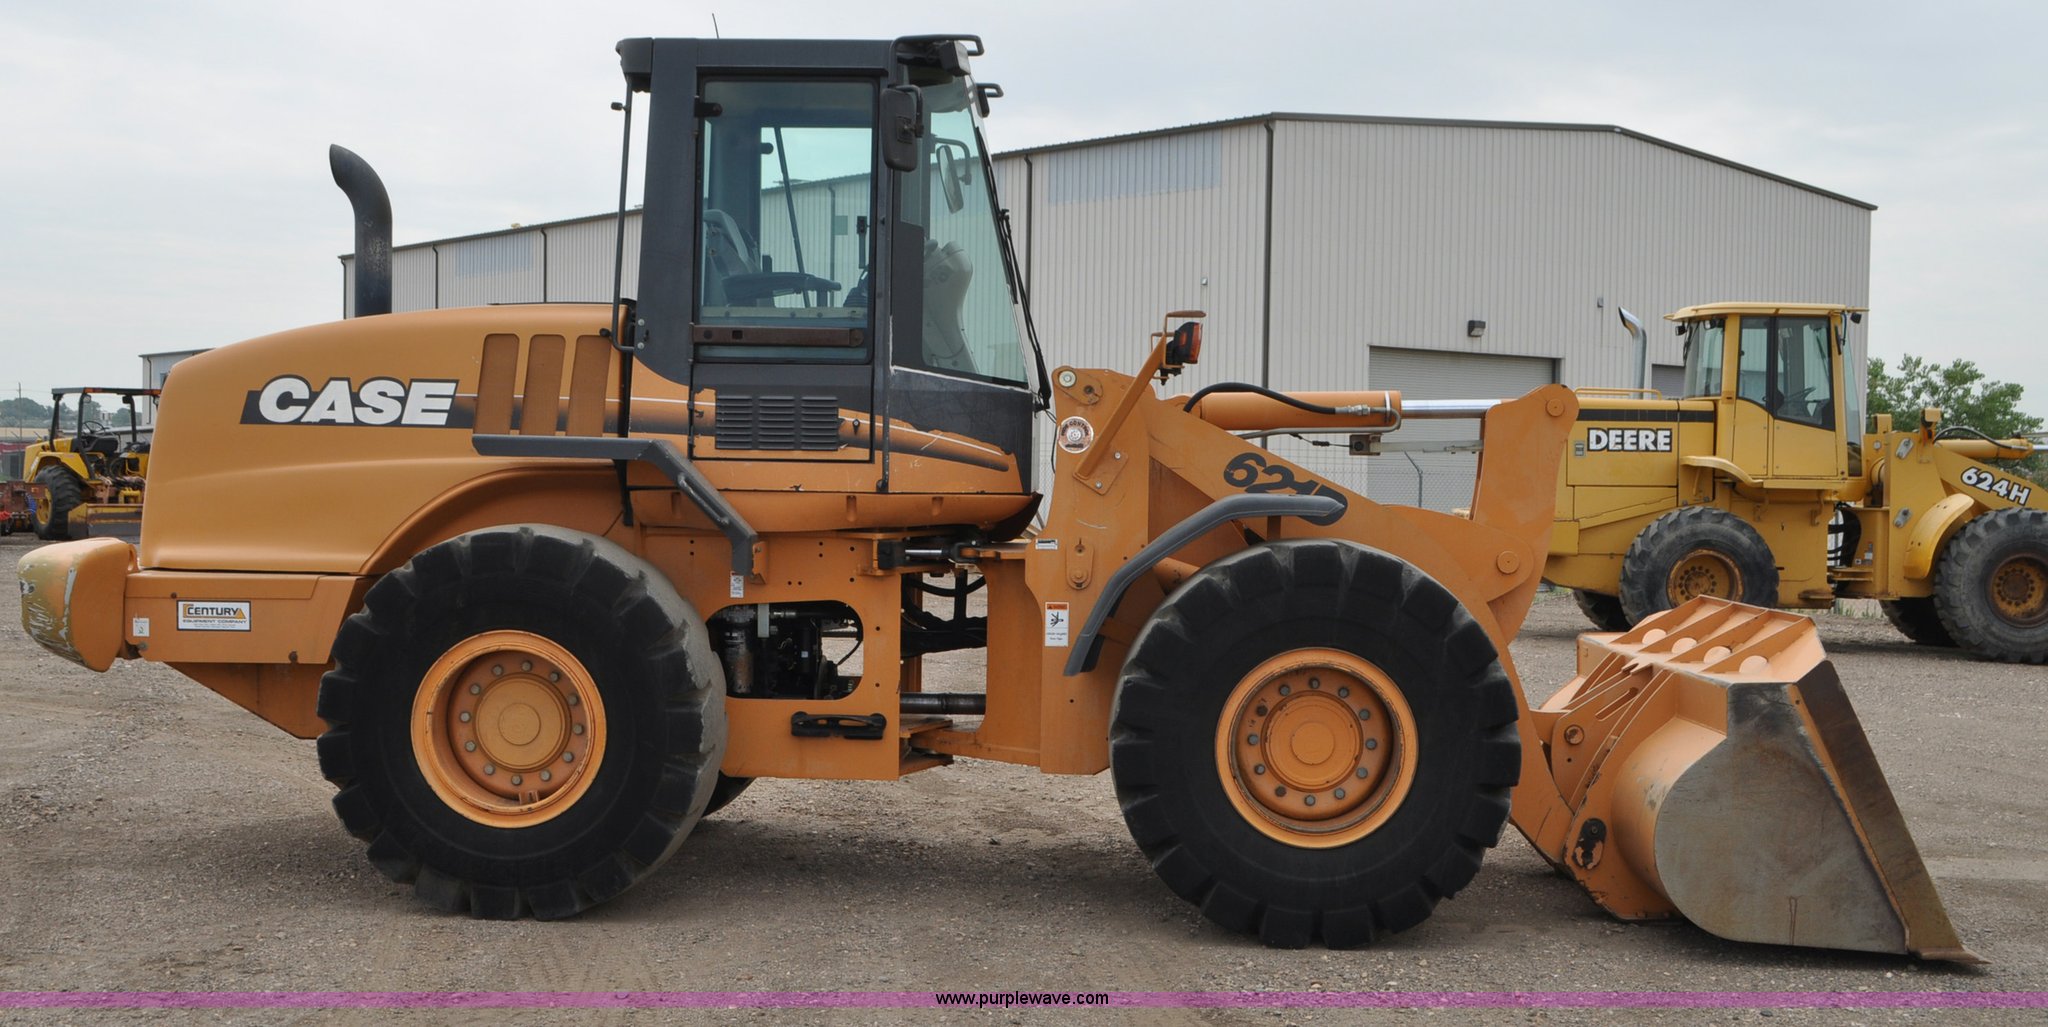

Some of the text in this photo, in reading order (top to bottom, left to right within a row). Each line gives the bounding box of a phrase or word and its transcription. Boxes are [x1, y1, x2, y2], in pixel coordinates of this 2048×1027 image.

[258, 376, 458, 426] CASE
[1587, 428, 1672, 452] DEERE
[1961, 466, 2031, 506] 624H
[187, 606, 239, 617] CENTURY
